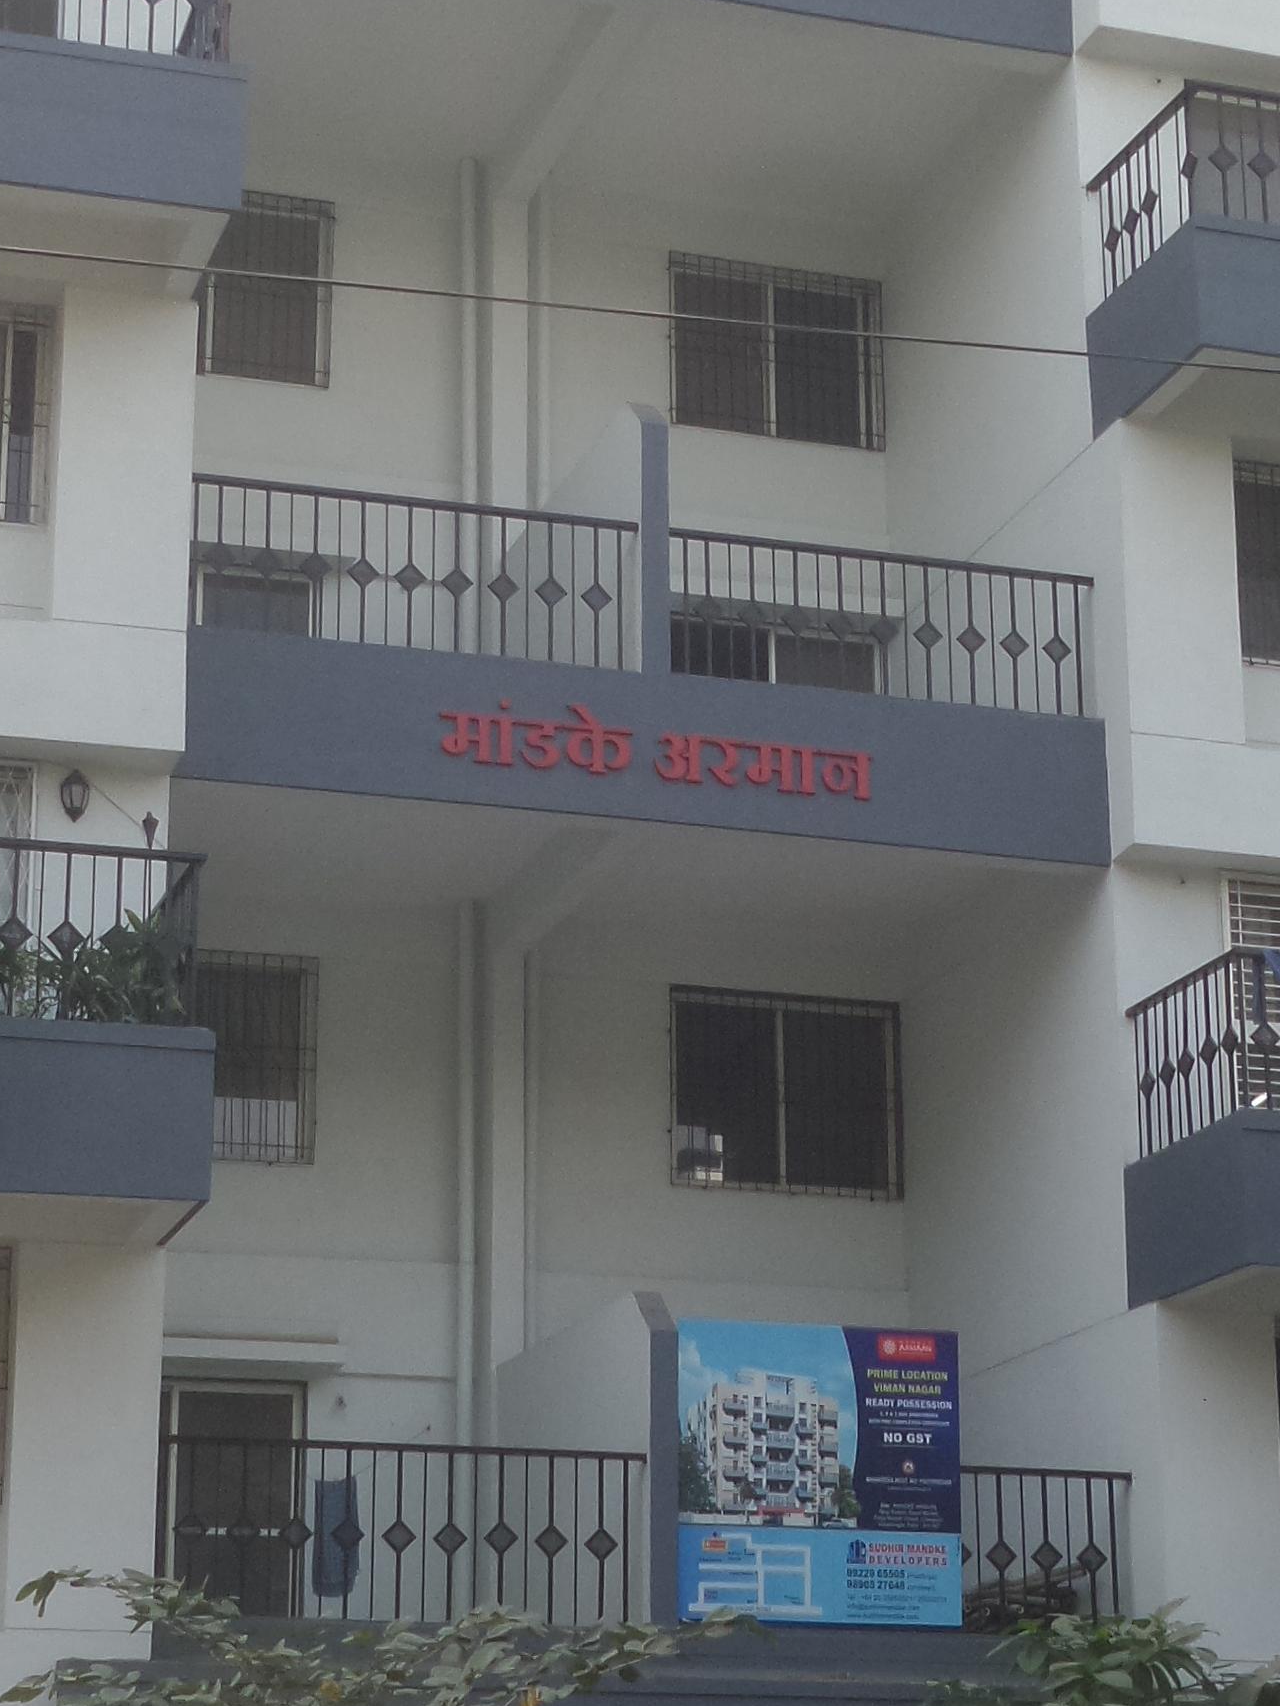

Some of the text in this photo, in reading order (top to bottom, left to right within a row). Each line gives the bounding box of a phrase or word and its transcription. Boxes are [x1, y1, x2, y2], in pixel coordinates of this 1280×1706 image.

[439, 698, 873, 802] मांडके अरमान
[867, 1368, 949, 1382] PRIME LOCATION
[873, 1383, 942, 1396] VIMAN NAGAR
[865, 1397, 953, 1411] READY POSSESSION
[883, 1431, 933, 1445] NO GST
[868, 1556, 948, 1566] DEVELOPERS
